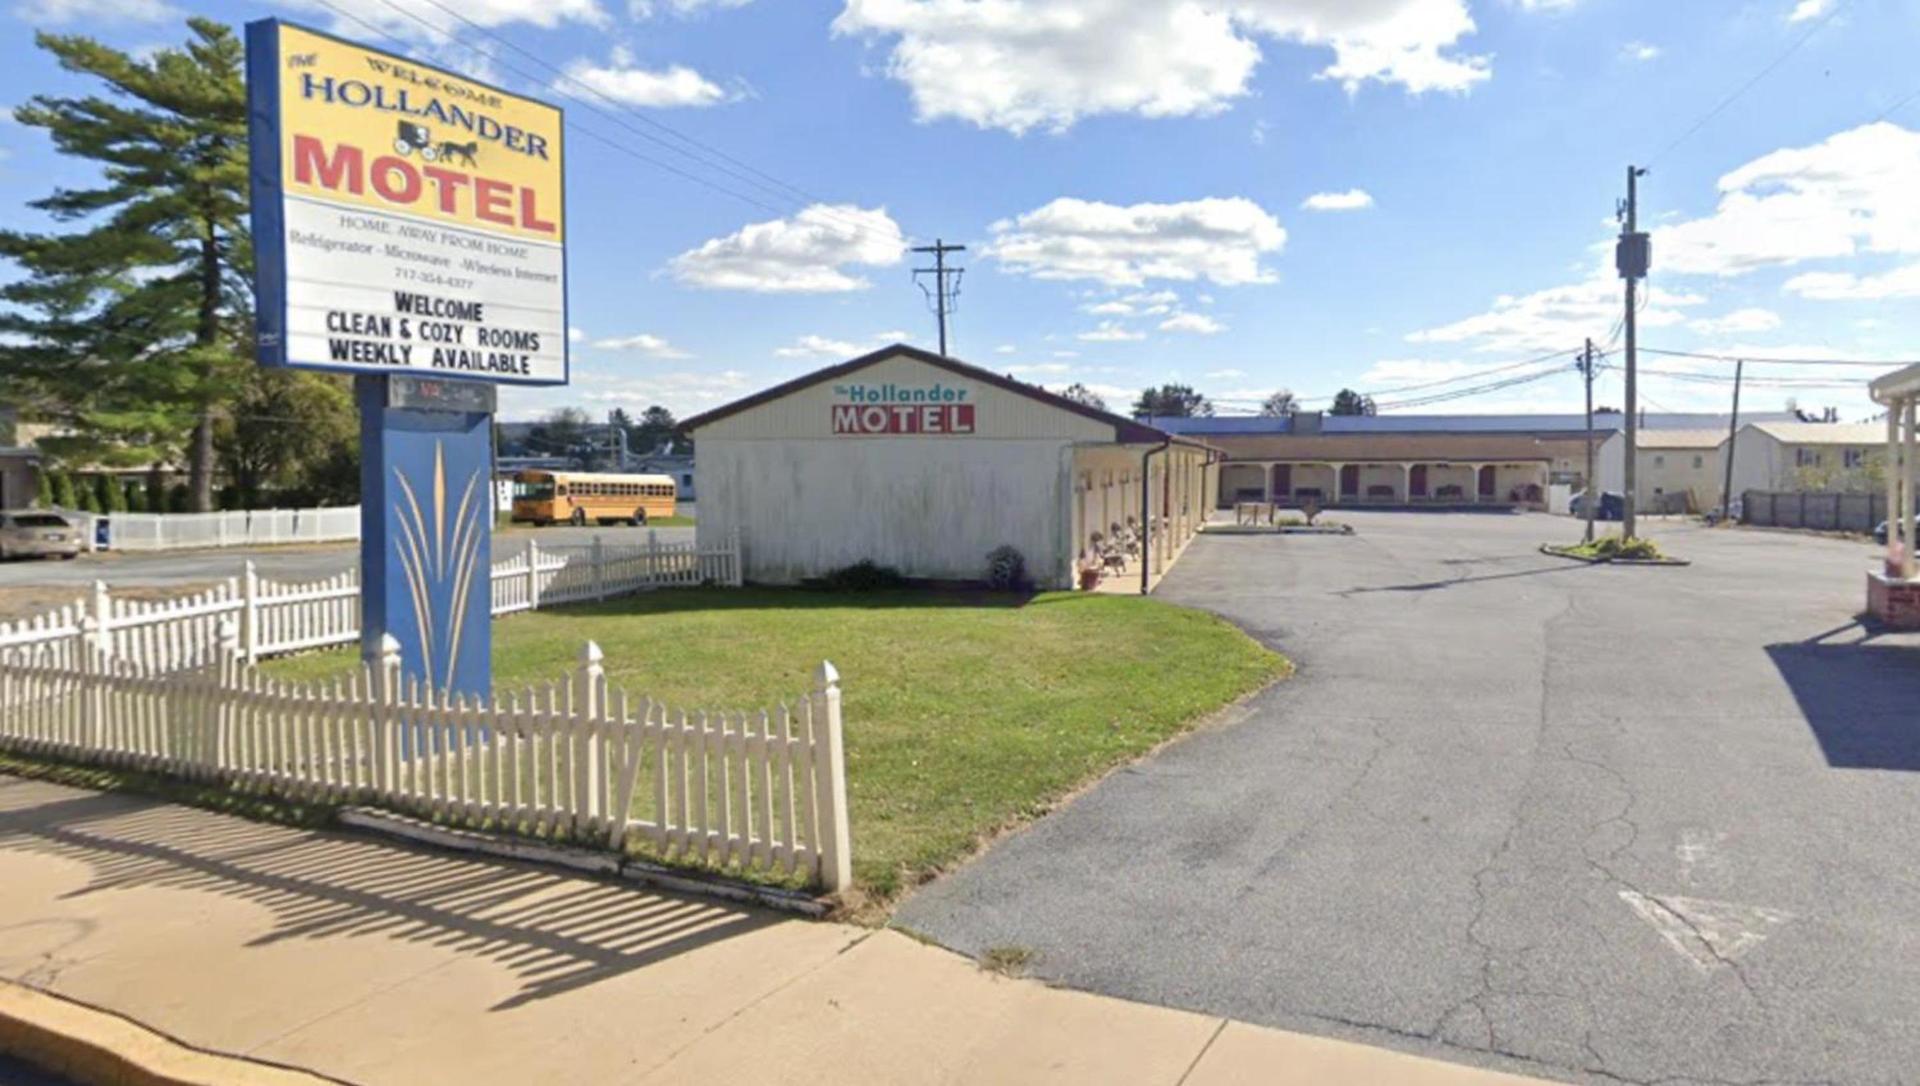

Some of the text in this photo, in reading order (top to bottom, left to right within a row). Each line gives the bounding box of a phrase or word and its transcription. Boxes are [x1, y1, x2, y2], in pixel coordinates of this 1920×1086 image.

[367, 56, 503, 109] WELCOME
[301, 73, 549, 161] HOLLANDER
[294, 134, 556, 233] MOTEL
[290, 229, 373, 254] Refrigerator
[384, 243, 451, 267] Microwave
[515, 267, 558, 285] Internet
[340, 214, 528, 259] HOME AWAY FROM HOME
[394, 290, 483, 322] WELCOME
[326, 311, 540, 352] CLEAN & COZY ROOMS
[328, 338, 531, 375] WEEKLY AVAILABLE
[850, 384, 967, 401] Hollander
[834, 406, 970, 432] MOTEL
